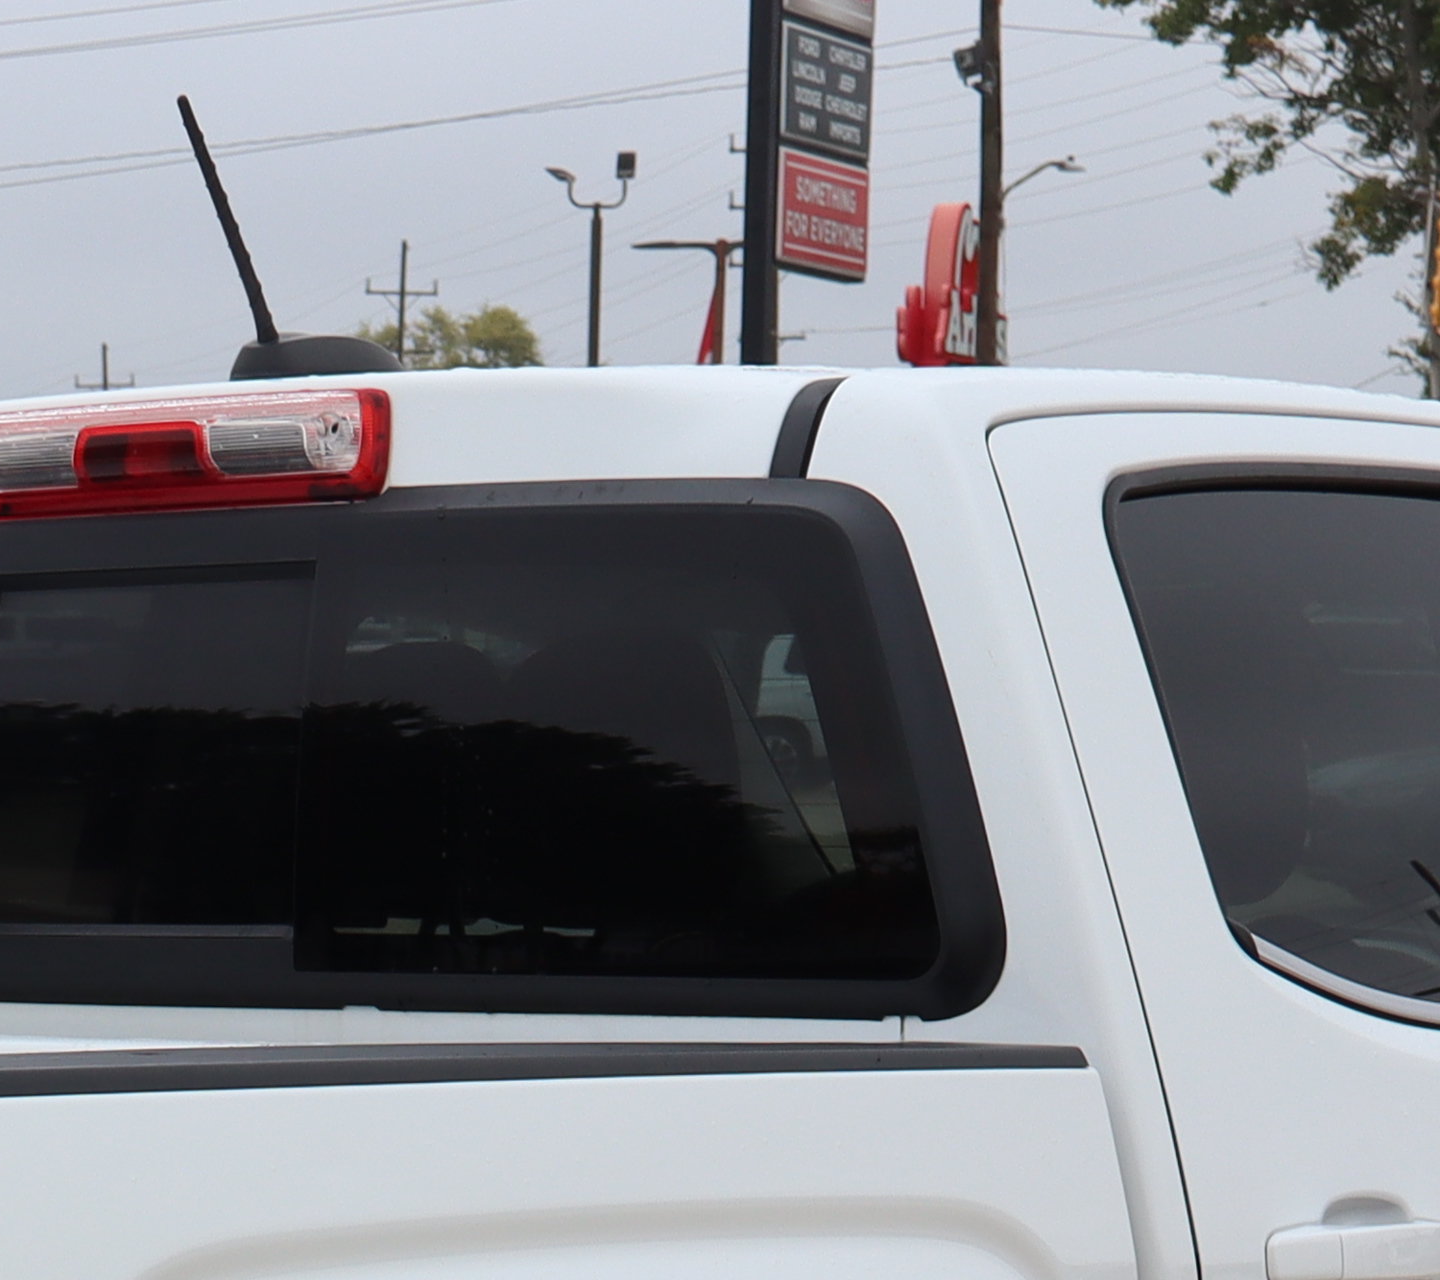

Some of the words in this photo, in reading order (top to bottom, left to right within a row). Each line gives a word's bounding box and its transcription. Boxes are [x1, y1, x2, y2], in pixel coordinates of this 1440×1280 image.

[795, 175, 857, 214] SOMETHING
[785, 209, 808, 239] FOR
[810, 215, 865, 252] EVERYONE
